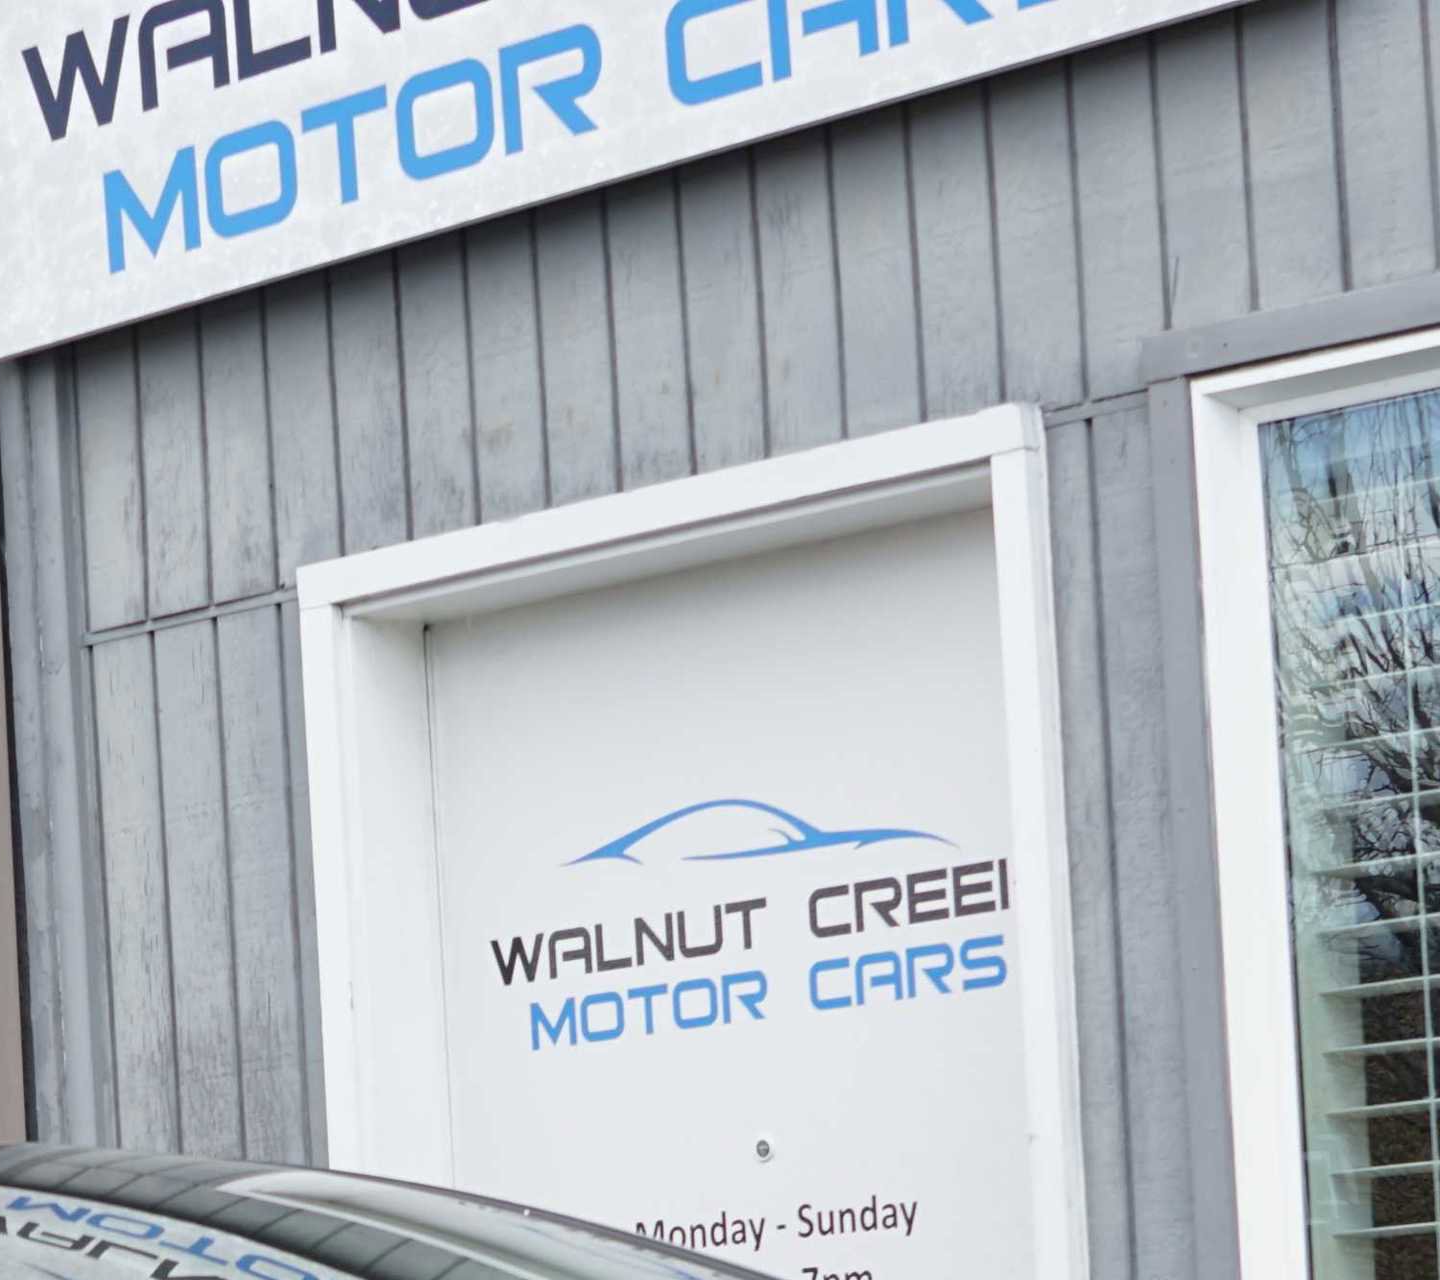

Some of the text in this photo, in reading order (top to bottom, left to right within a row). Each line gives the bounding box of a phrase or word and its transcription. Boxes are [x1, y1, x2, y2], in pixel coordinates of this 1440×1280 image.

[22, 0, 488, 141] WALN
[101, 0, 1051, 274] MOTOR CA
[490, 897, 768, 987] WALNUT
[529, 933, 1008, 1051] MOTOR CARS
[797, 1194, 918, 1238] Sunday
